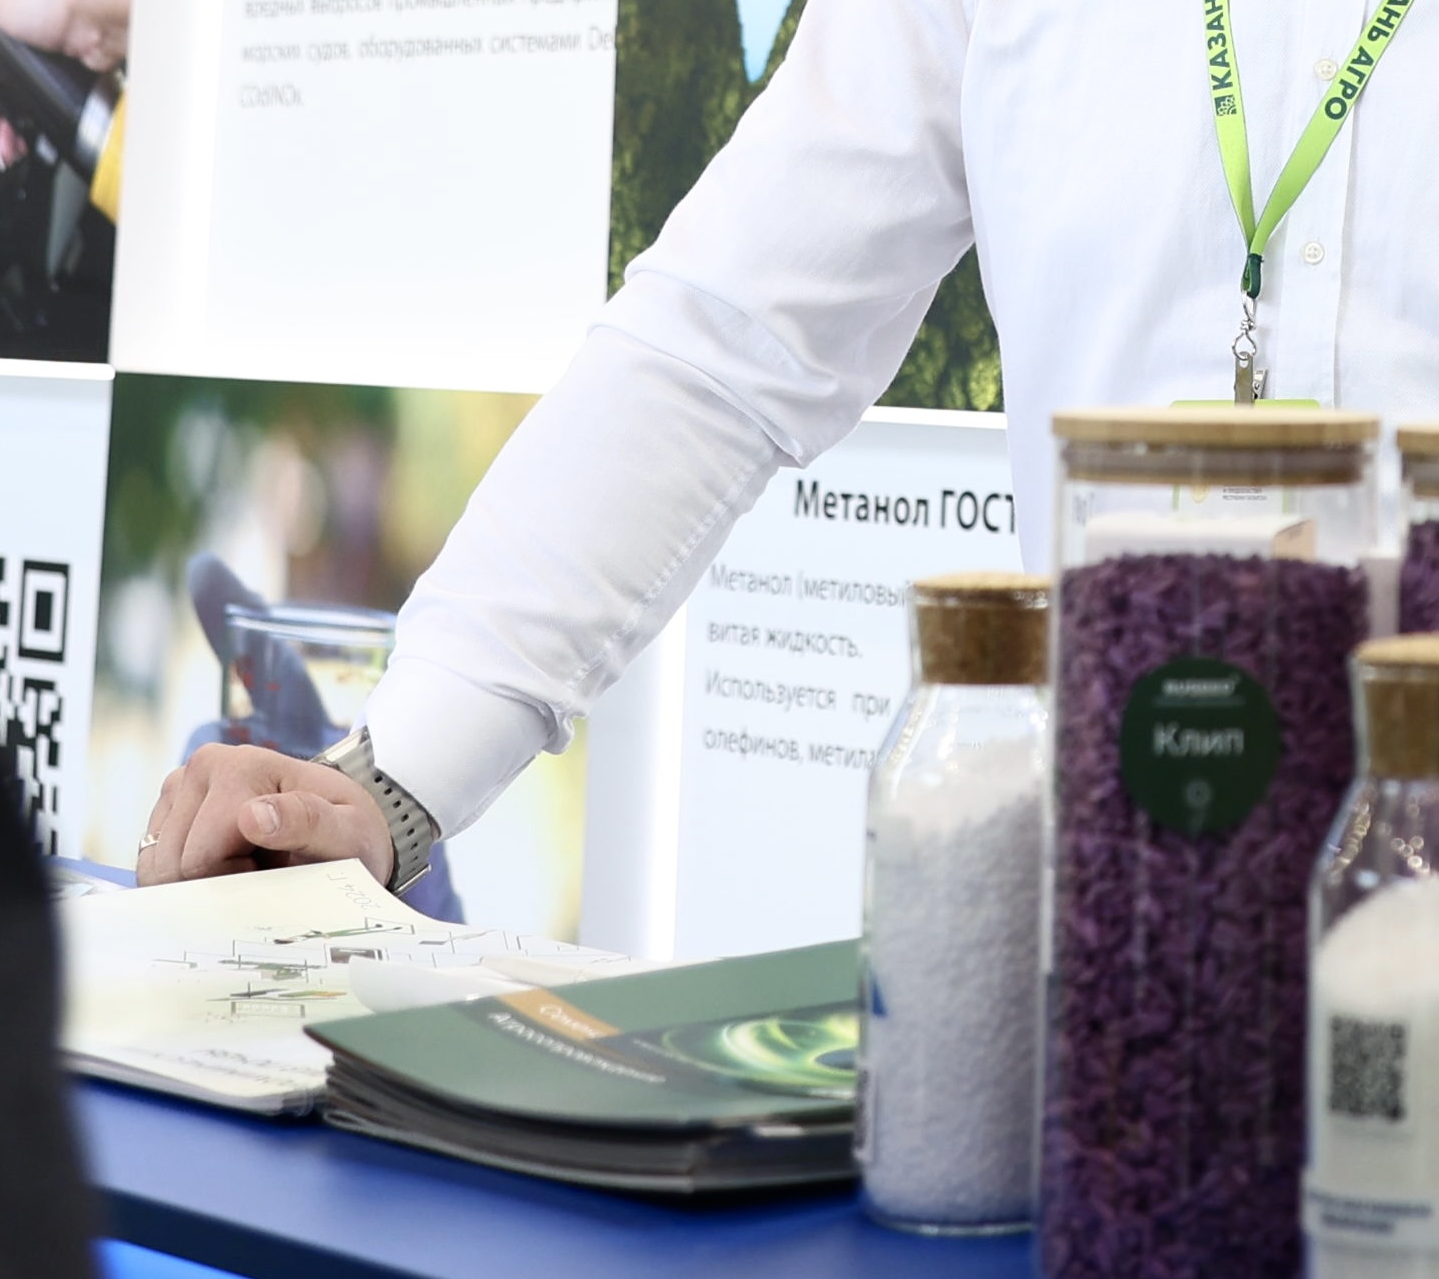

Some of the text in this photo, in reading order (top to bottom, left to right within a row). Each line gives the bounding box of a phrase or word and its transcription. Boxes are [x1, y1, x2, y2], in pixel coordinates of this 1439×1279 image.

[1324, 45, 1376, 120] АГРО
[794, 478, 930, 528] Метанол
[706, 620, 863, 659] витая жидкость.
[705, 669, 891, 723] Используется при
[1153, 721, 1245, 758] Клип
